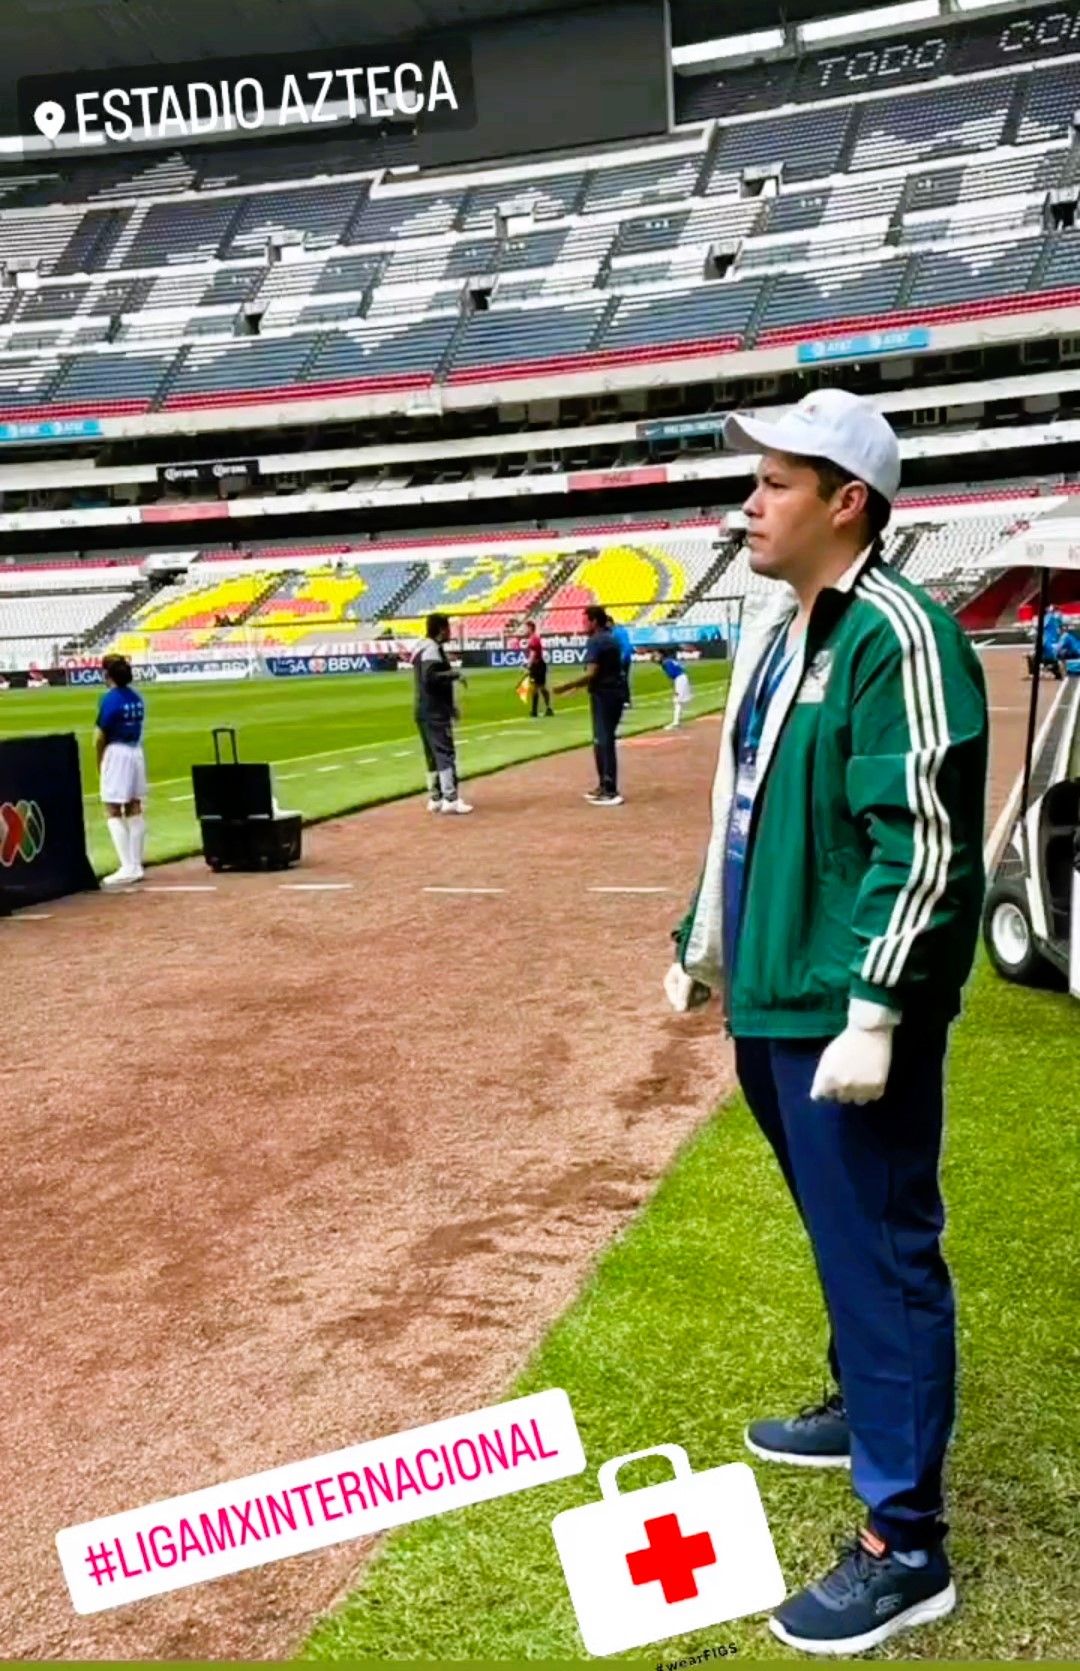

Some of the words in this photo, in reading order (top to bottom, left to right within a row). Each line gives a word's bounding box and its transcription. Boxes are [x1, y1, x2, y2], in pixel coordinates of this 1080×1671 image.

[817, 38, 947, 87] TODO
[328, 657, 371, 672] BBVA
[491, 652, 530, 666] LIGA
[552, 649, 588, 664] BBV
[70, 668, 102, 684] LIGA
